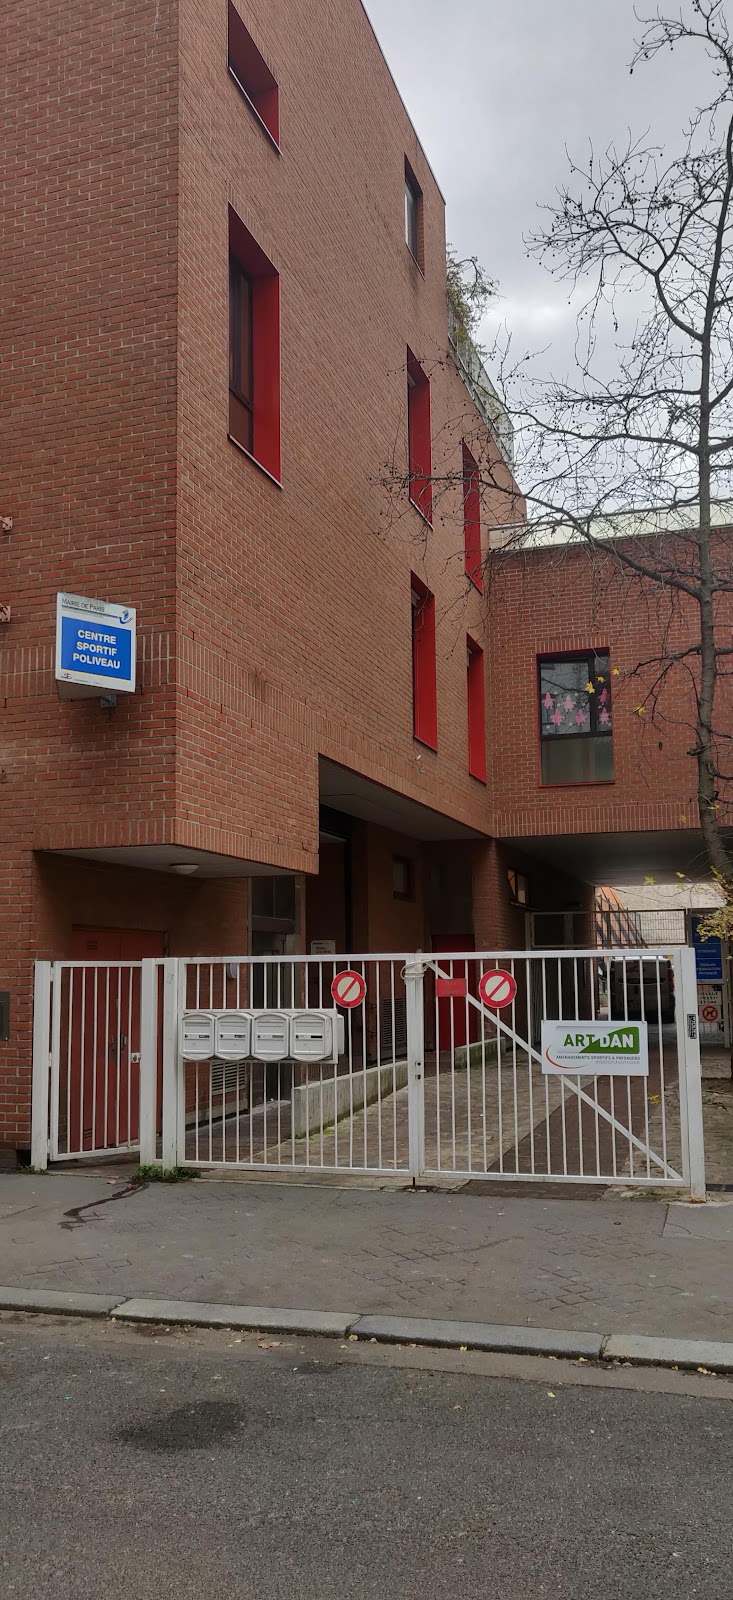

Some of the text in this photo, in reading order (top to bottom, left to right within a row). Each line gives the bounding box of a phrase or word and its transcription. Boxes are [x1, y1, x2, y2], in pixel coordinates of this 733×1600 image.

[77, 629, 117, 645] CENTRE
[76, 641, 118, 657] SPORTIF
[72, 652, 121, 669] POLIVEAU
[563, 1033, 634, 1048] ART DAN
